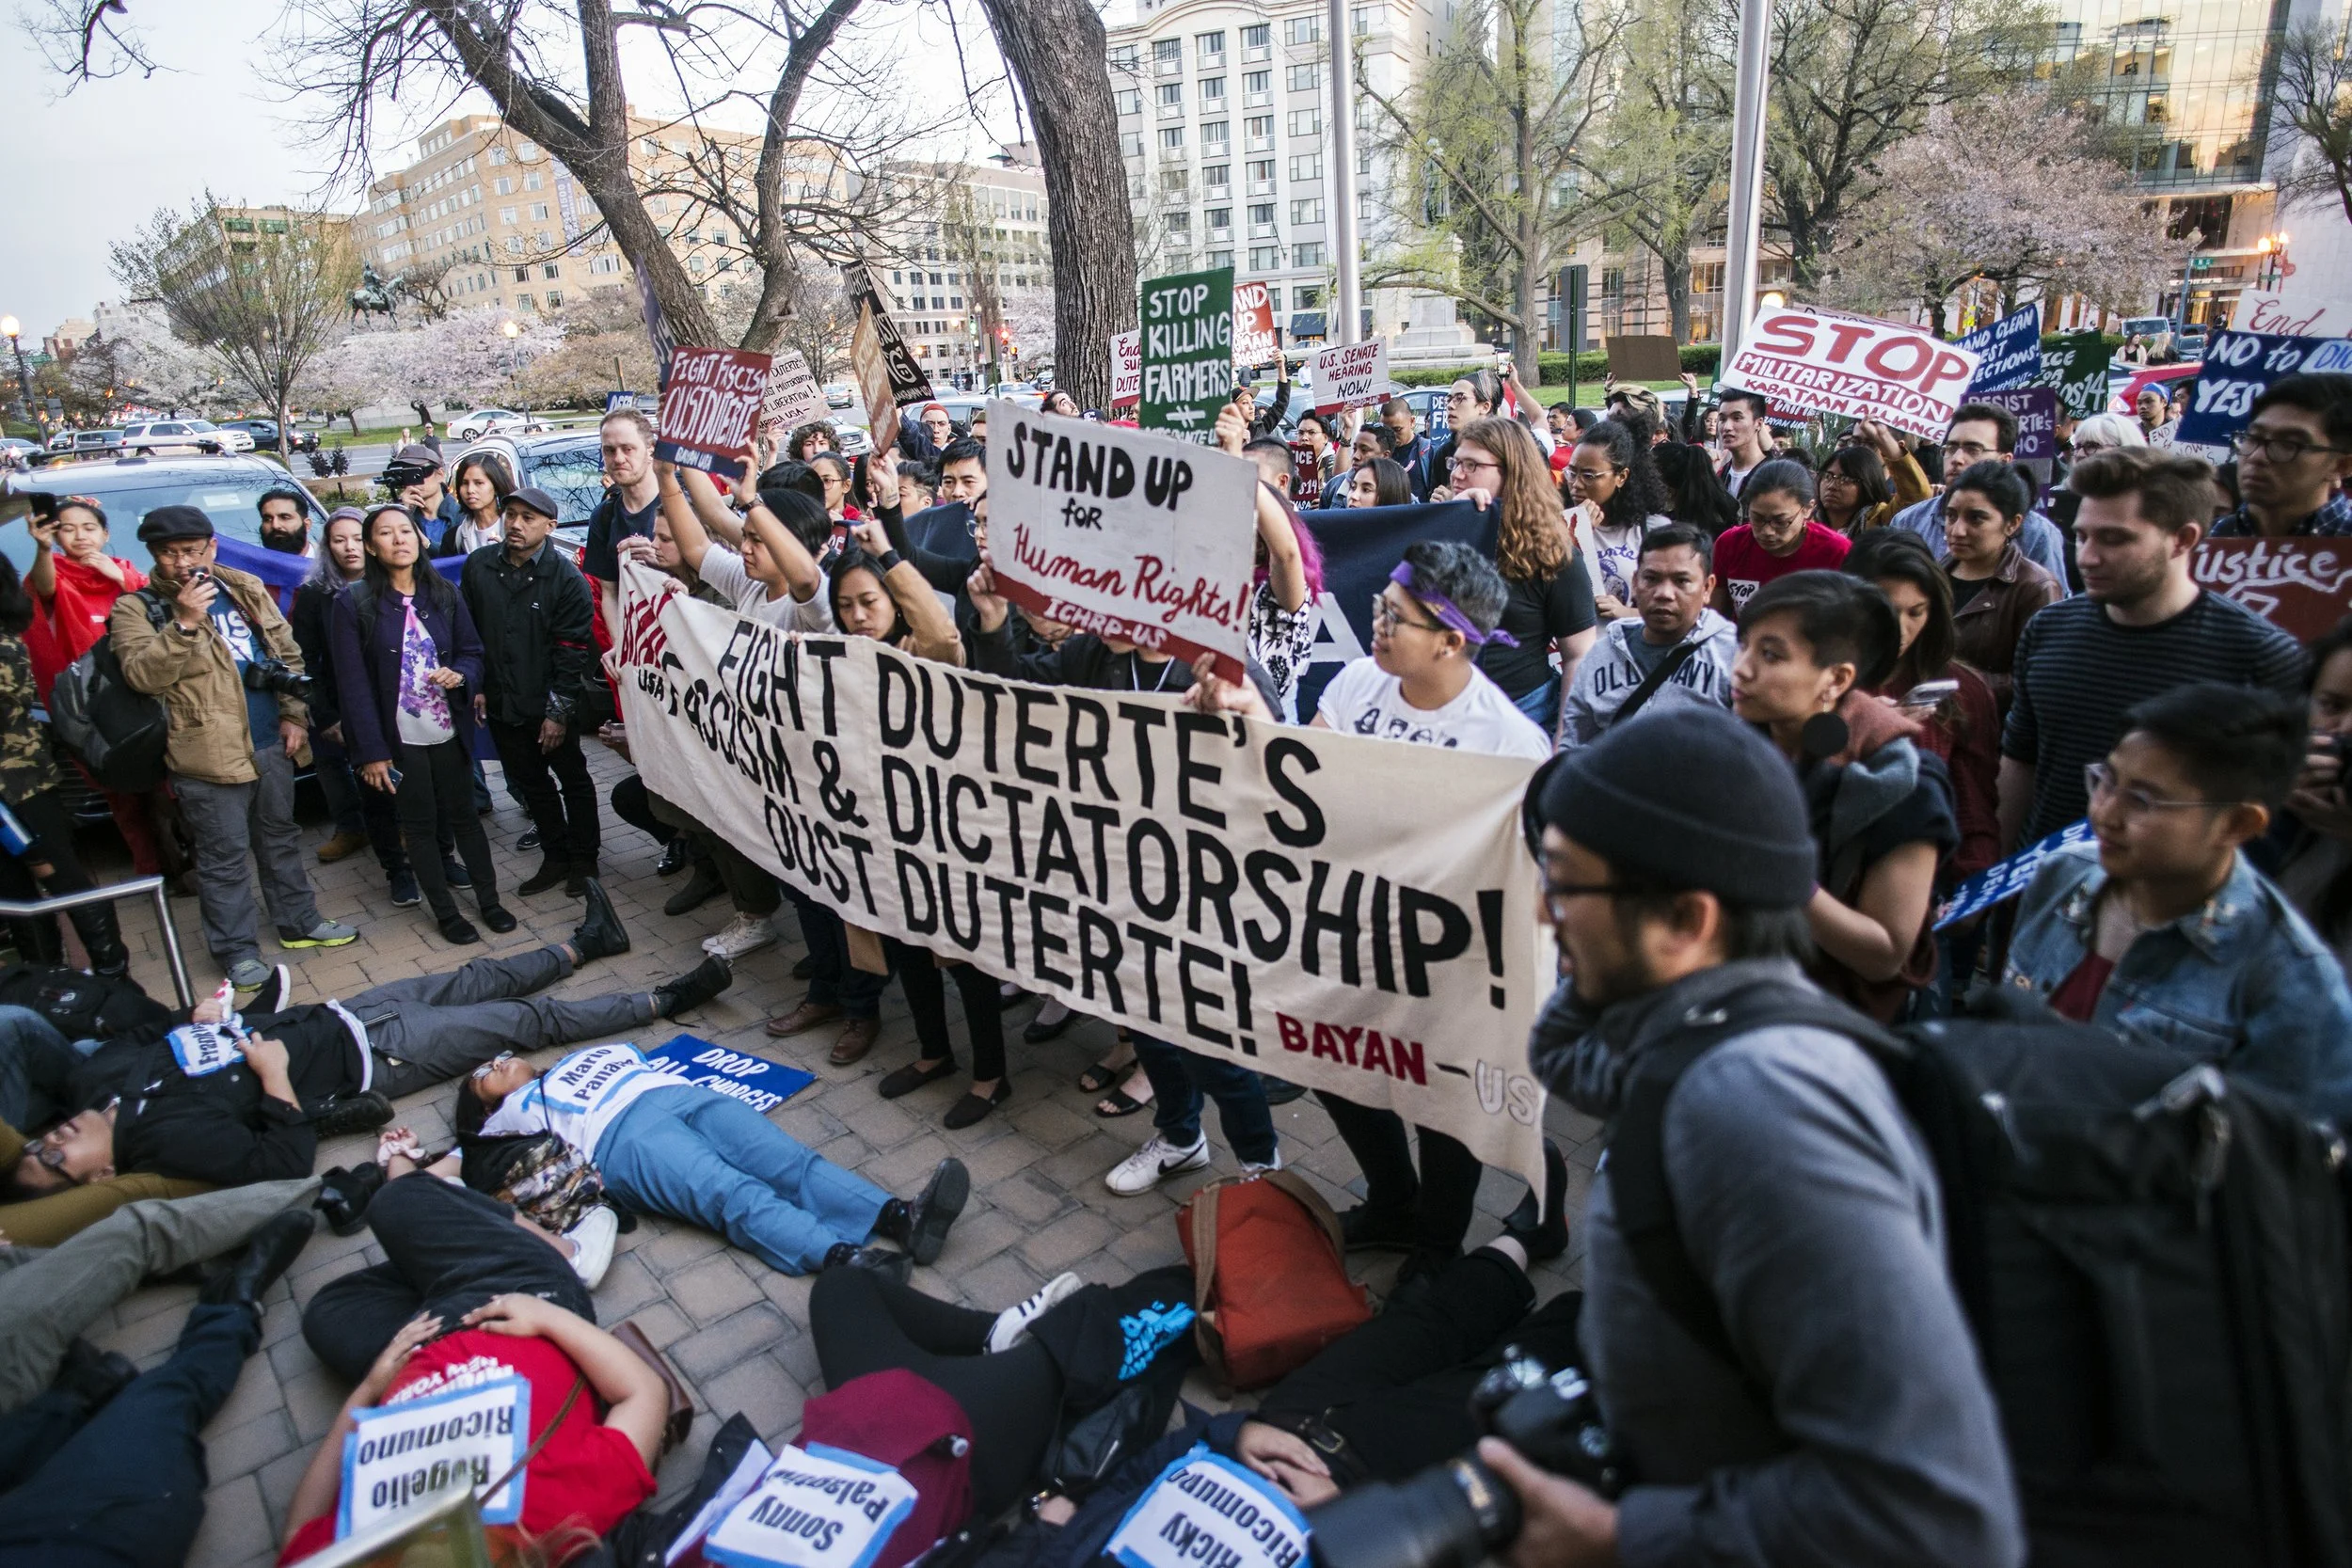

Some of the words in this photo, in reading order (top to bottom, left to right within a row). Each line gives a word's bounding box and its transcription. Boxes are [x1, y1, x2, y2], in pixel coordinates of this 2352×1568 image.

[1149, 284, 1208, 319] STOP
[1232, 285, 1267, 314] AND
[2249, 297, 2326, 338] End
[1149, 311, 1231, 359] KILLING
[1233, 329, 1274, 353] UMAN
[1995, 311, 2034, 339] CLEAN
[670, 352, 721, 384] FIGHT
[1319, 355, 1338, 369] U.S.
[1342, 342, 1379, 365] SENATE
[1328, 361, 1373, 382] HEARING
[1754, 315, 1969, 394] STOP
[1971, 340, 2040, 385] ECTIONS!
[1979, 340, 2009, 365] EST
[2041, 349, 2076, 369] ICE
[2208, 334, 2262, 367] NO
[2264, 340, 2301, 372] to
[1116, 373, 1141, 392] DUTE
[1145, 358, 1230, 404] FARMERS
[1337, 378, 1372, 399] NOW!
[1739, 353, 1949, 423] MILITARIZATION
[2194, 378, 2266, 418] YES
[1432, 395, 1447, 410] DE
[1744, 378, 1850, 414] KABATAAN
[1852, 404, 1946, 442] ALLIANCE
[2018, 409, 2054, 432] RTE'S
[1007, 421, 1136, 499] STAND
[1144, 455, 1194, 512] UP
[1292, 450, 1313, 465] ICE
[1013, 522, 1127, 597] Human
[1133, 554, 1250, 633] Rights!
[1729, 583, 1756, 598] STOP
[1042, 598, 1168, 649] ICHRP-US
[638, 669, 664, 702] USA
[1671, 657, 1715, 695] AVY
[717, 619, 847, 738] FIGHT
[876, 651, 1327, 849] DUTERTE'S
[813, 739, 869, 830] &
[882, 753, 1506, 1011] DICTATORSHIP!
[764, 793, 880, 917] OUST
[895, 847, 1259, 1058] DUTERTE!
[559, 1048, 612, 1087] Mario
[691, 1048, 771, 1078] DROP
[645, 1055, 690, 1075] ALL
[691, 1074, 784, 1113] CHARGES
[358, 1404, 515, 1465] Ricomuno
[372, 1454, 491, 1510] Rogelio
[749, 1494, 845, 1552] Sonny
